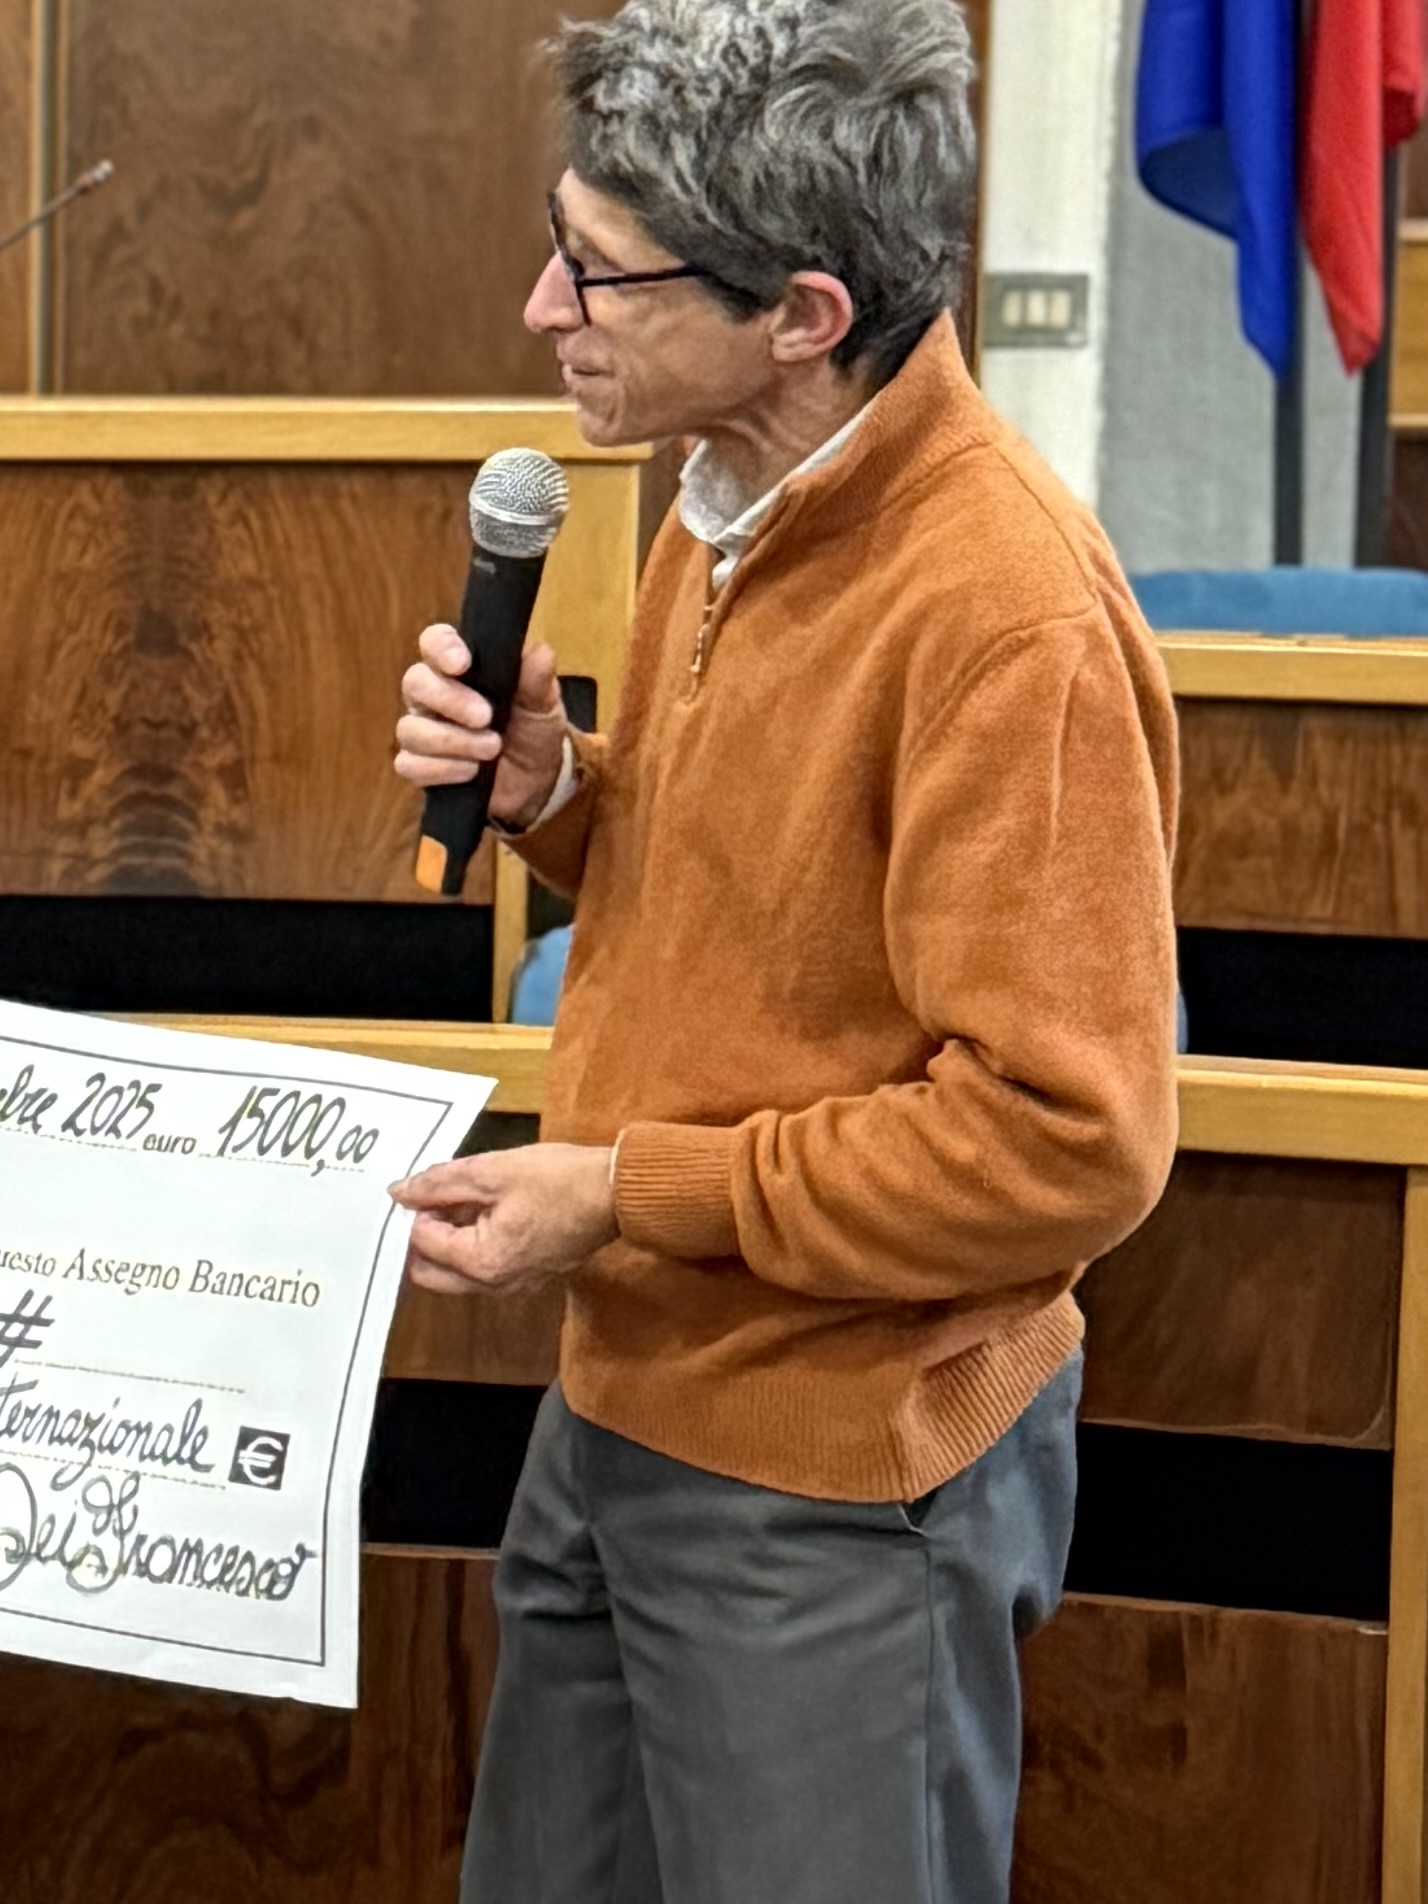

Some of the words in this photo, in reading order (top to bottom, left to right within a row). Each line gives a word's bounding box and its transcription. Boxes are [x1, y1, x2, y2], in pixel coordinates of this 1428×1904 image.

[60, 1071, 164, 1141] 2025
[141, 1132, 198, 1156] euro
[215, 1085, 380, 1177] 15000,00
[61, 1247, 181, 1296] Assegno
[188, 1258, 322, 1309] Bancario
